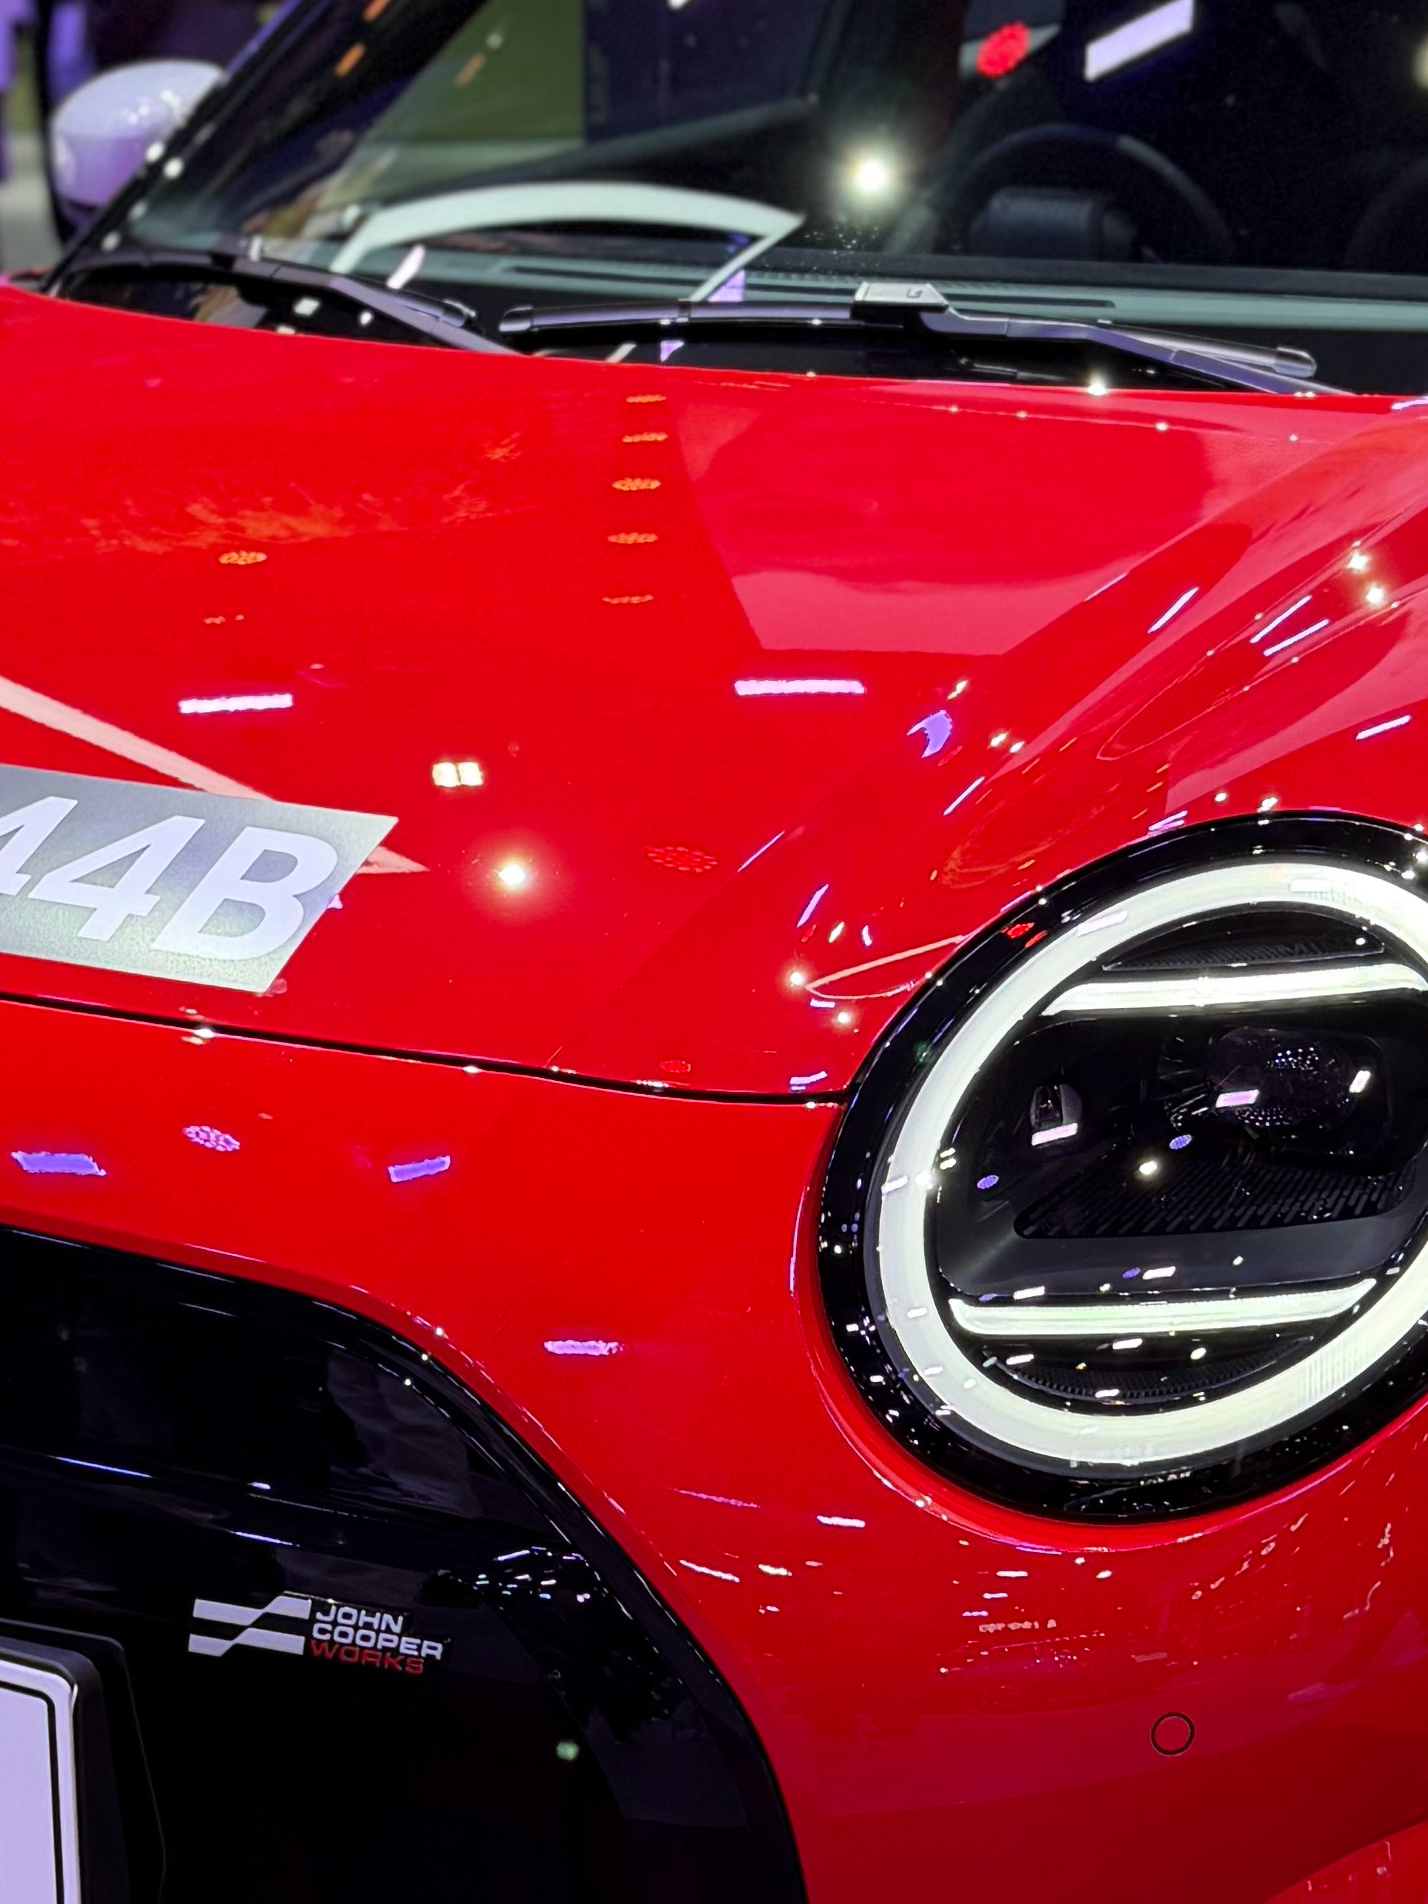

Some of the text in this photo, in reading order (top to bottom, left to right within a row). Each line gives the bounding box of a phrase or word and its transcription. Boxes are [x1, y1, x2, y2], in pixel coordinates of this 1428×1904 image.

[315, 1605, 403, 1633] JOHN
[309, 1640, 425, 1675] WORKS
[312, 1622, 444, 1660] COOPER
